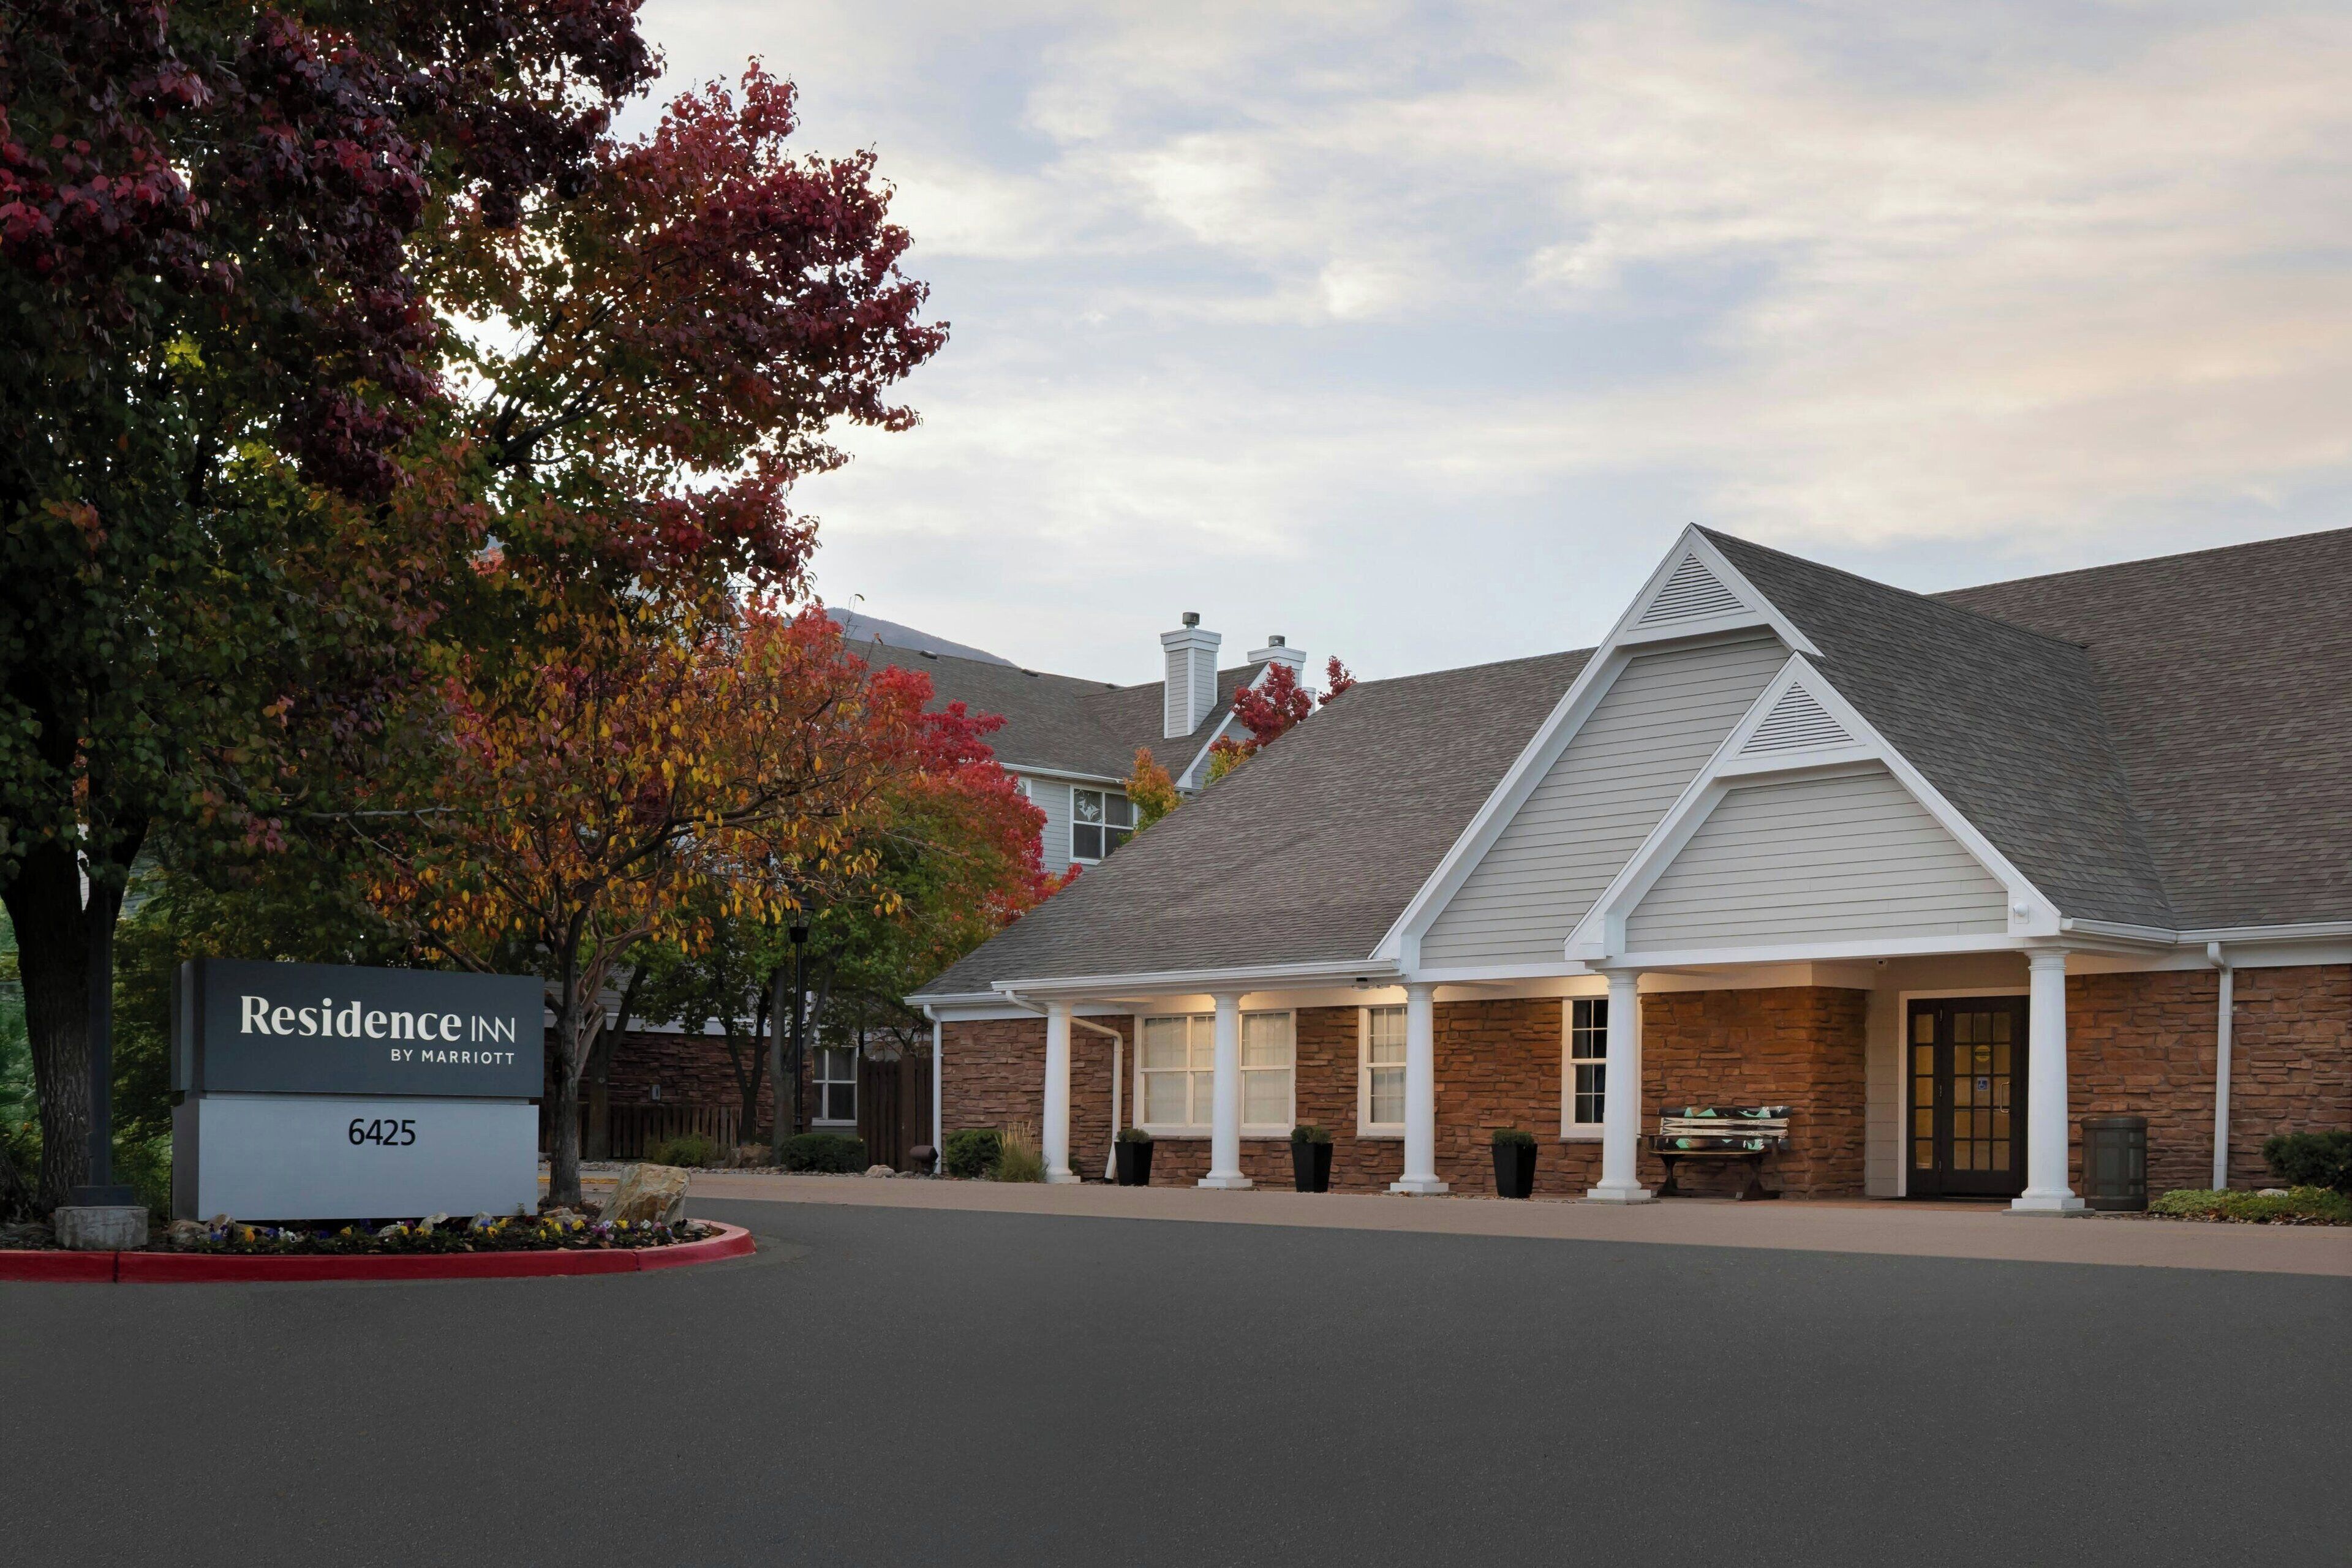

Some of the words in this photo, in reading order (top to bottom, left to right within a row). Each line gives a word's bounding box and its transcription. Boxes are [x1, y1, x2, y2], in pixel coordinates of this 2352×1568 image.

[240, 995, 462, 1042] Residence
[471, 1015, 515, 1043] INN
[391, 1049, 413, 1061] BY
[421, 1049, 515, 1065] MARRIOTT
[349, 1118, 416, 1146] 6425
